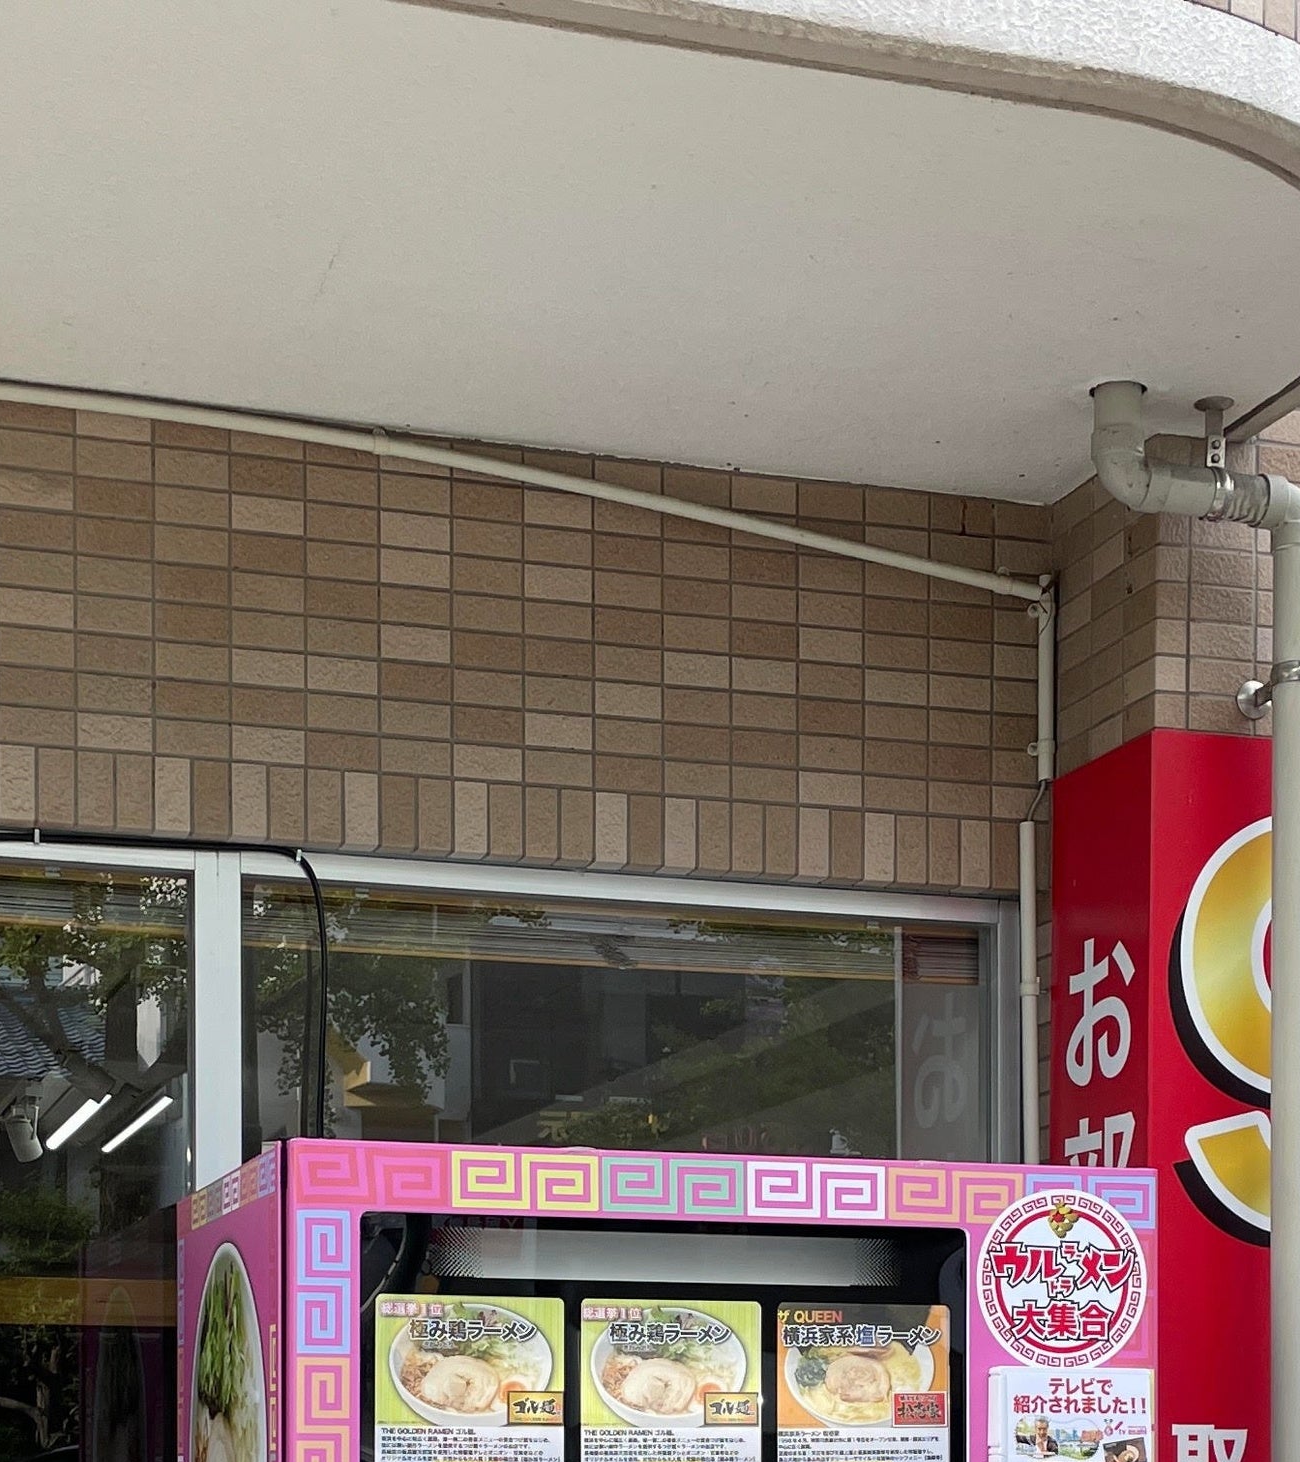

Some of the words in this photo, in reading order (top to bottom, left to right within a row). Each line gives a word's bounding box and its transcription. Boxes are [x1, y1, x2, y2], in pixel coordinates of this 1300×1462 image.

[794, 1310, 843, 1323] QUEEN
[1015, 1303, 1109, 1338] 大集合
[409, 1319, 538, 1341] 極み鶏ラーメン
[610, 1323, 732, 1345] 極み鶏ラーメン
[783, 1325, 941, 1347] 横浜家系塩ラーメン
[1049, 1377, 1113, 1395] テレビで
[1014, 1395, 1146, 1414] 紹介されました!!
